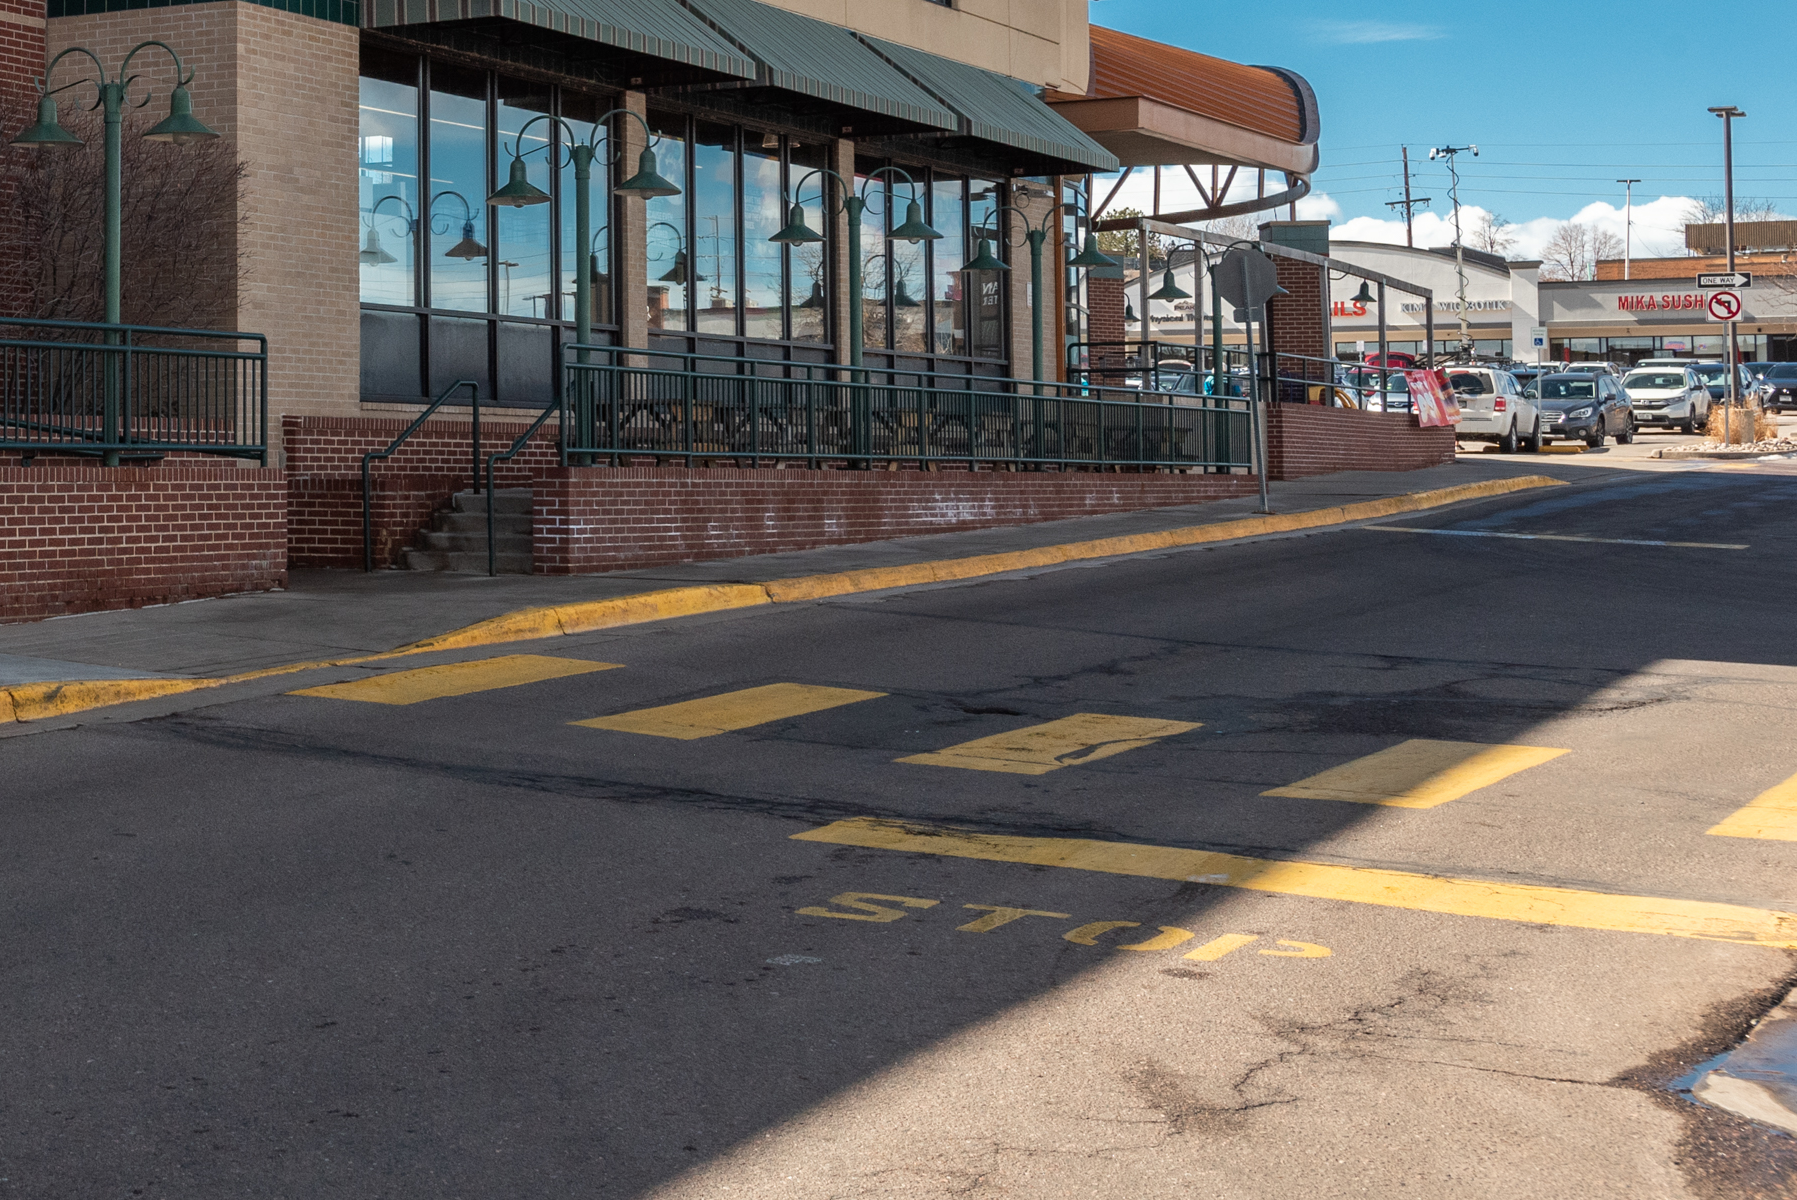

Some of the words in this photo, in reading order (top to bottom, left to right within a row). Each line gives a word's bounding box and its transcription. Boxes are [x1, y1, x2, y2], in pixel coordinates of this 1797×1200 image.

[1330, 300, 1367, 317] ILS
[1618, 295, 1658, 311] MIKA
[1661, 294, 1706, 310] SUSH
[1150, 313, 1184, 325] hysical
[794, 891, 1333, 962] STOP
